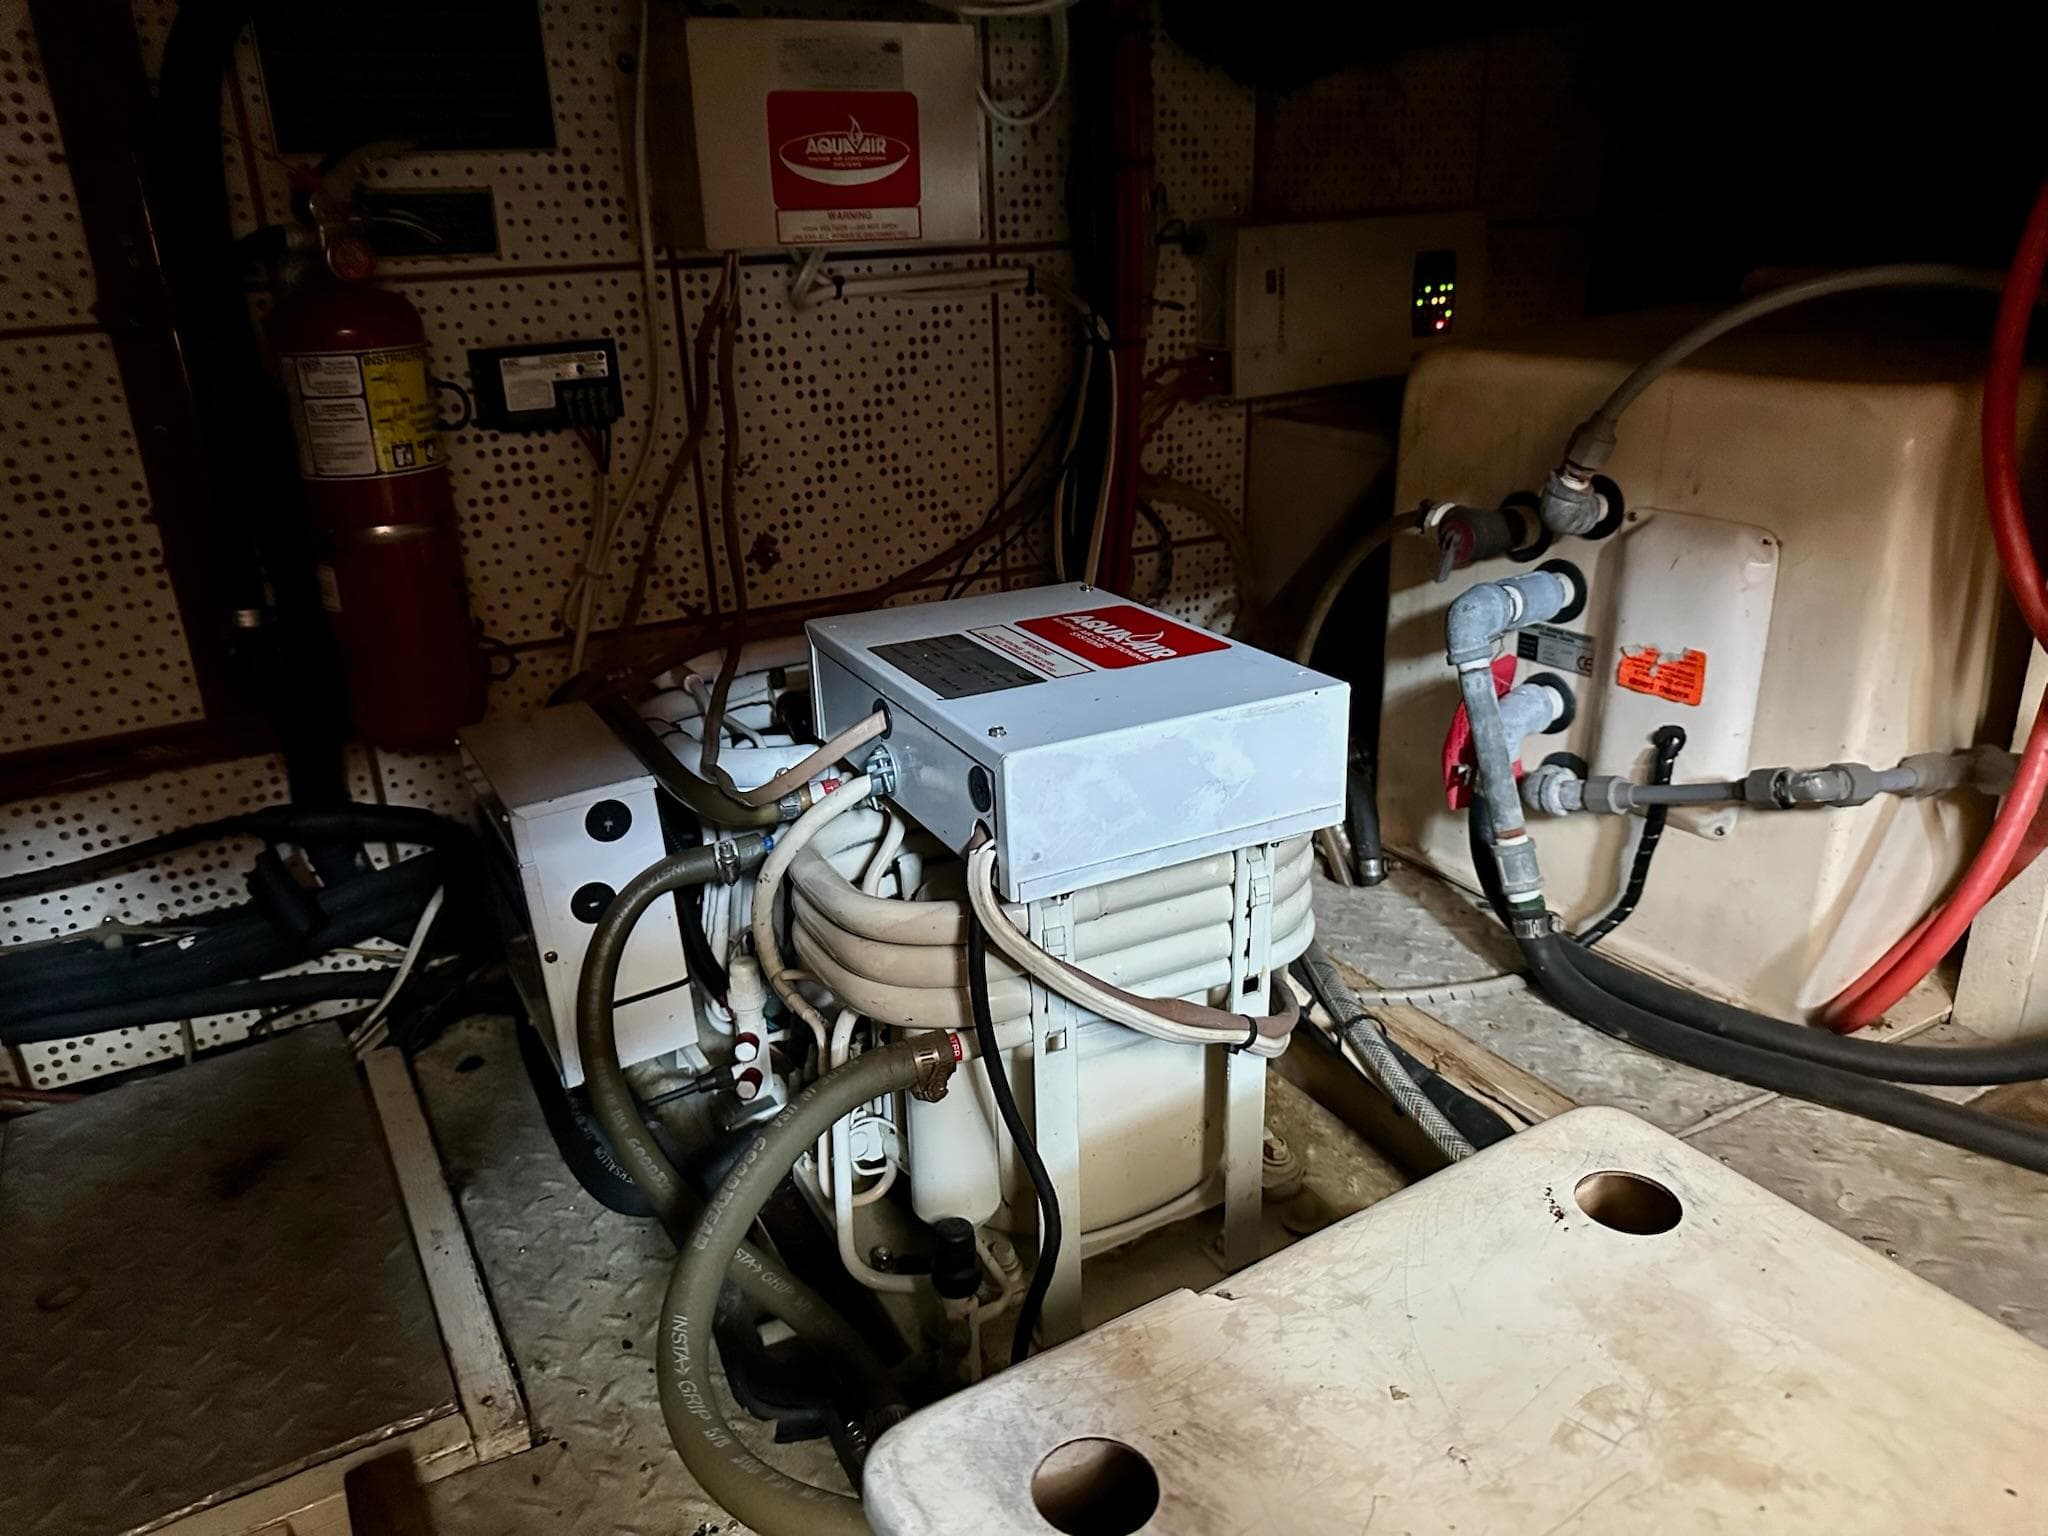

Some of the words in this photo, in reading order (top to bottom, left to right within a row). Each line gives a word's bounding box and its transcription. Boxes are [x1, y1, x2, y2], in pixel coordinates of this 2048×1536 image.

[827, 211, 872, 221] WARNING
[693, 1136, 767, 1251] GOODYEAR
[677, 1379, 713, 1422] GRIP
